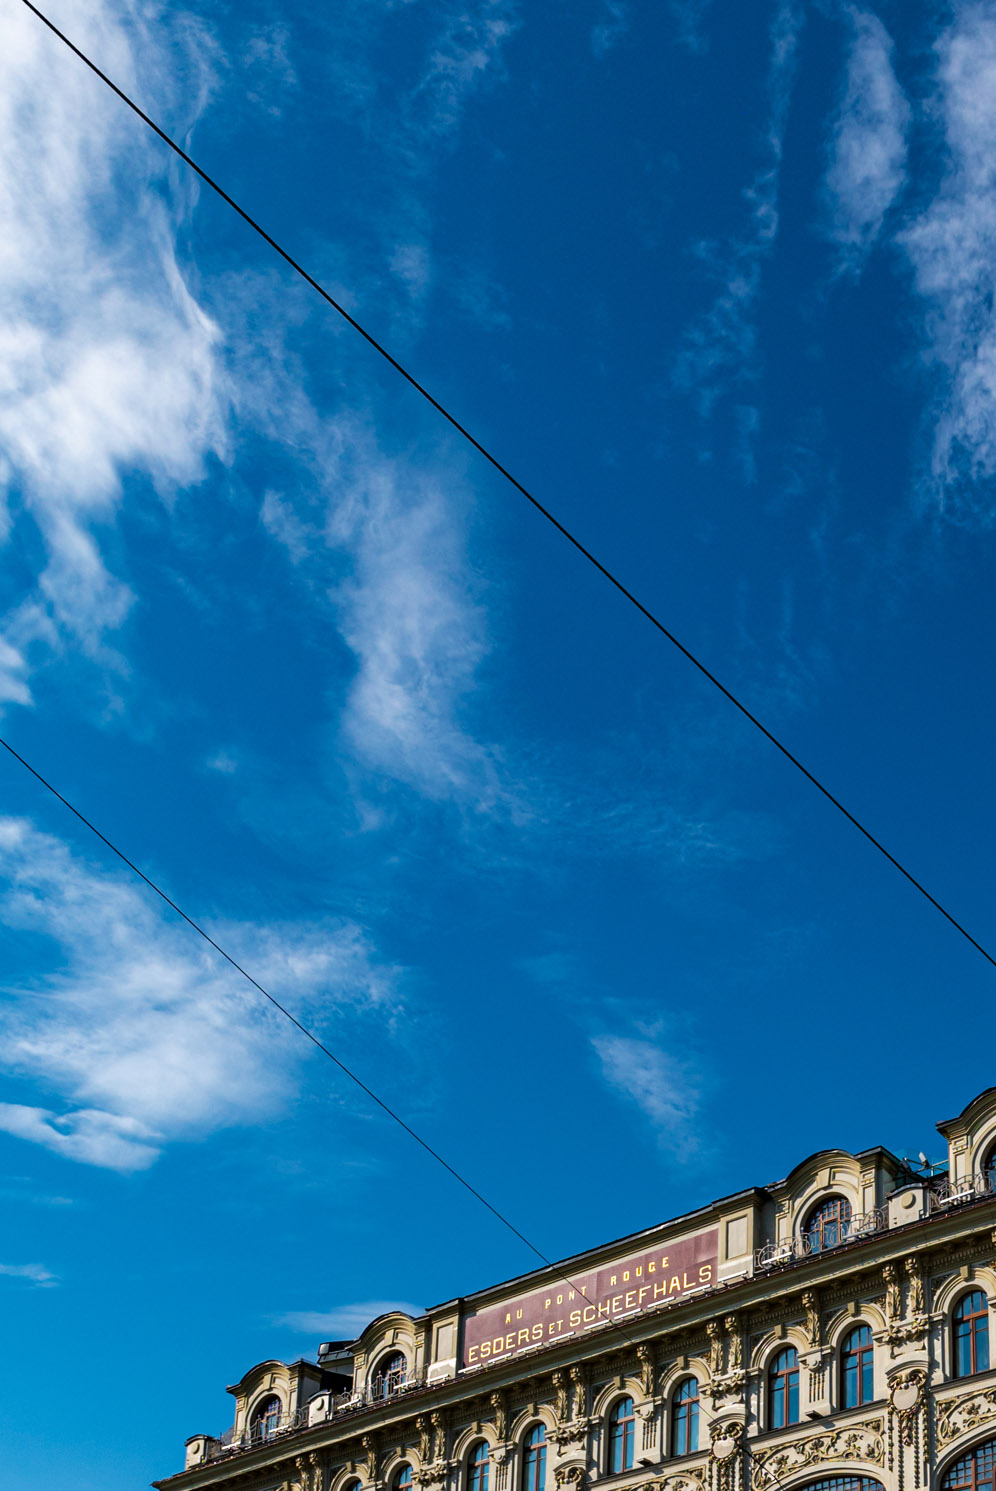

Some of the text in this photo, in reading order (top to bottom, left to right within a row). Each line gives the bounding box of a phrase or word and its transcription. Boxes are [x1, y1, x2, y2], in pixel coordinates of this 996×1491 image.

[468, 1264, 712, 1363] ESDERS ET SCHEEFHALS
[505, 1256, 669, 1324] AU PONT ROUGE
